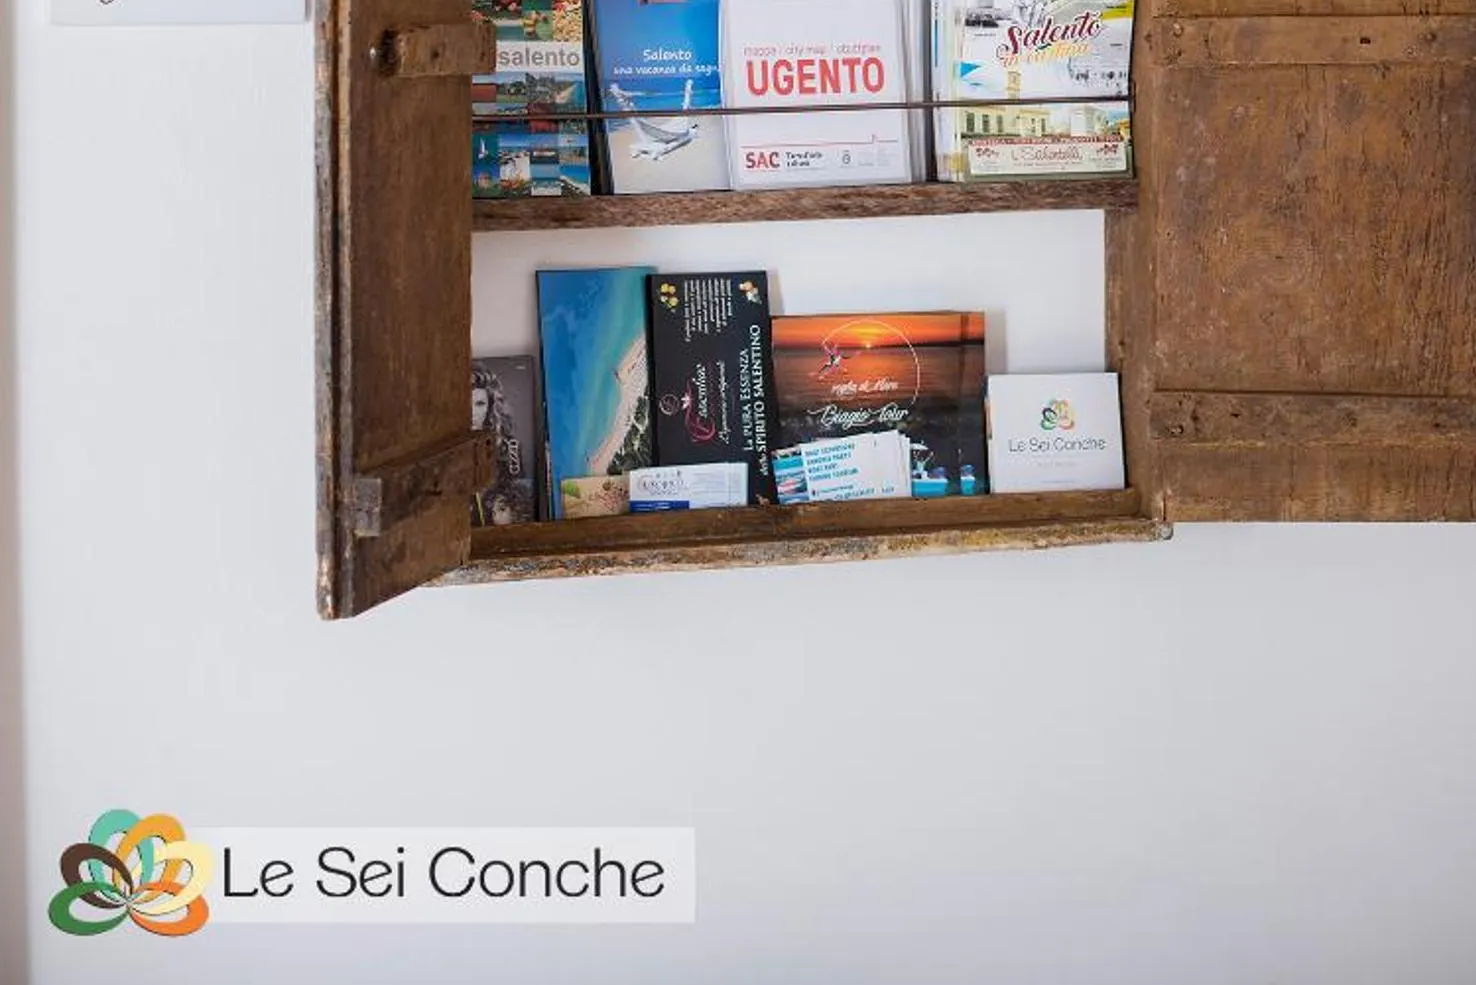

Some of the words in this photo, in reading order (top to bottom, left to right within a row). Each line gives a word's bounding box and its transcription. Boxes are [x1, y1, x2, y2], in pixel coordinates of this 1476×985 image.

[996, 11, 1103, 60] Salento
[499, 47, 581, 67] salento
[643, 48, 692, 62] Salento
[746, 57, 885, 96] UGENTO
[745, 152, 780, 169] SAC
[739, 348, 751, 401] ESSENZA
[750, 324, 764, 398] SALENTINO
[741, 404, 753, 437] PURA
[754, 400, 767, 453] SPIRITO
[1009, 439, 1026, 452] Le
[1029, 437, 1050, 452] Sei
[1053, 437, 1106, 452] Conche
